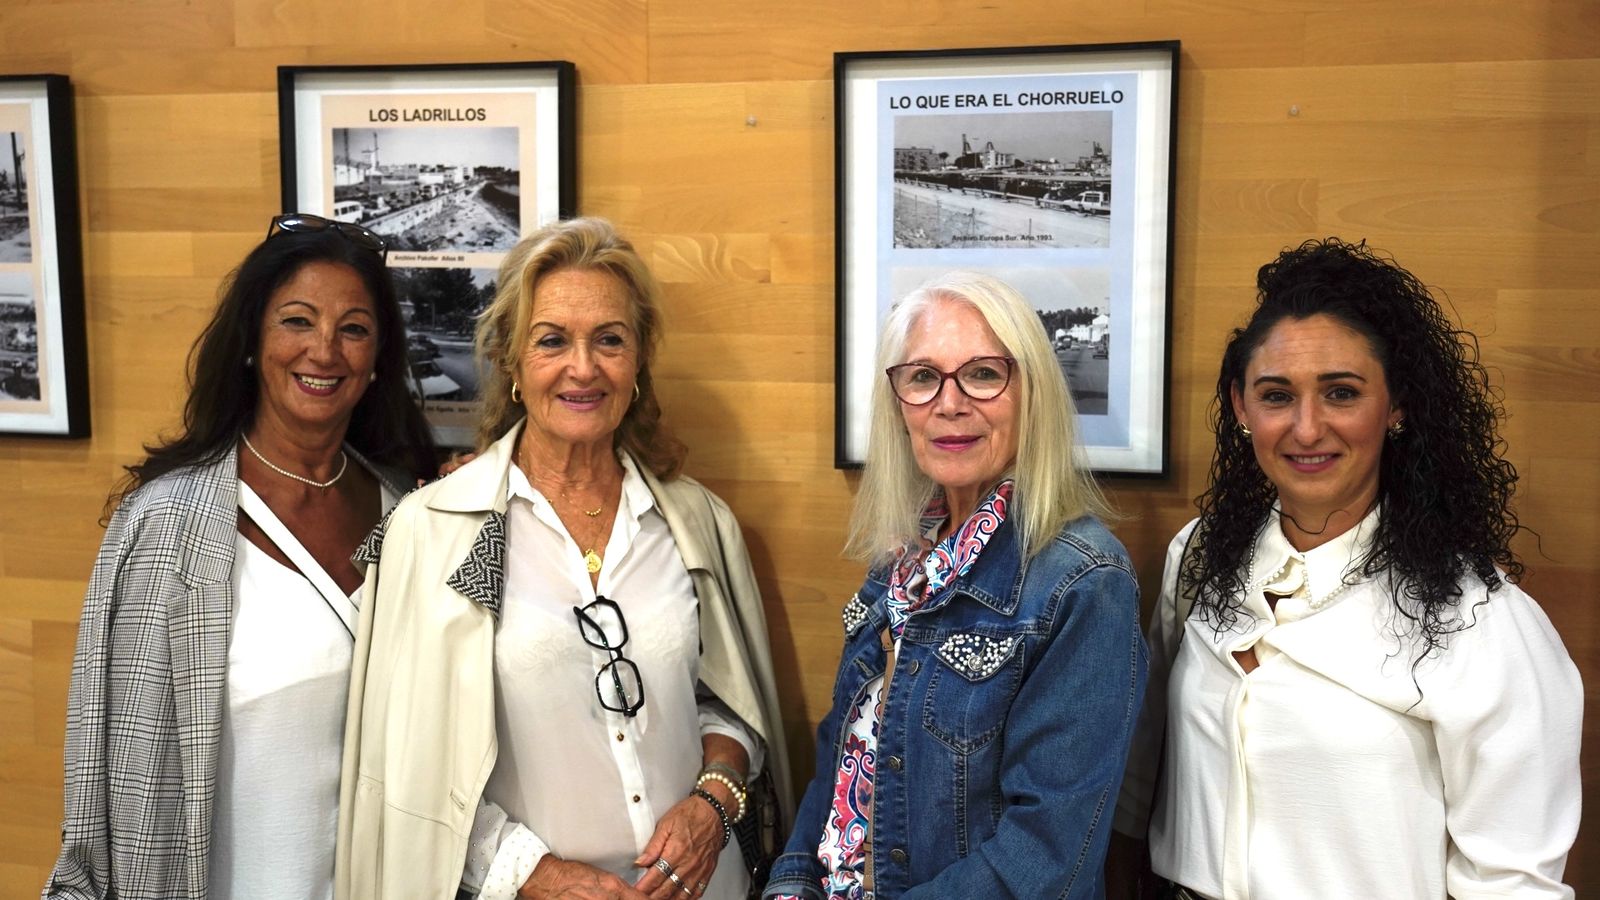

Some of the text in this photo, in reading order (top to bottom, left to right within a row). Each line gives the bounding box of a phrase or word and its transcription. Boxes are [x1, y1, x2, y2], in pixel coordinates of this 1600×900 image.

[890, 90, 1124, 109] LO QUE ERA EL CHORRUELO
[369, 107, 486, 122] LOS LADRILLOS
